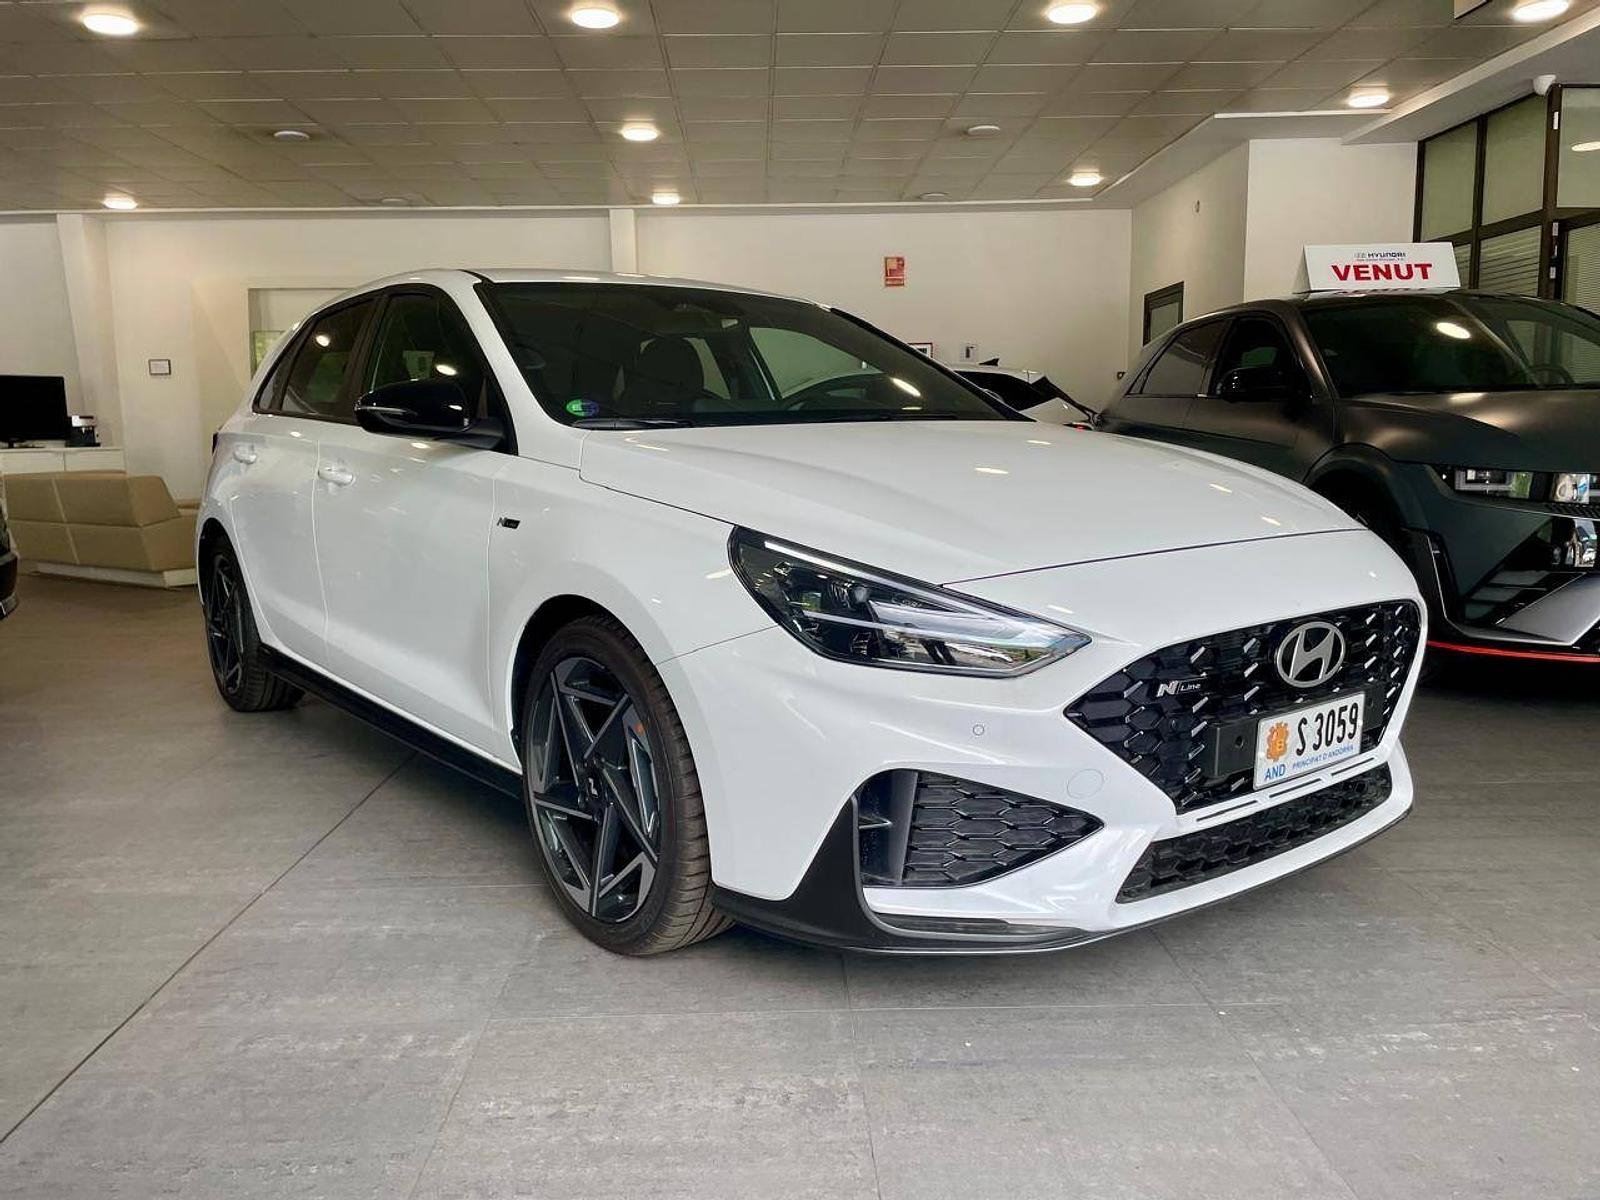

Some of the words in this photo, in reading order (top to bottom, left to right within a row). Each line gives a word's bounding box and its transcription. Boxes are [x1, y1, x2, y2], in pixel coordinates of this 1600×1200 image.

[1331, 263, 1433, 281] VENUT
[1296, 716, 1308, 756] S
[1312, 702, 1359, 751] 3059
[1264, 763, 1286, 781] AND
